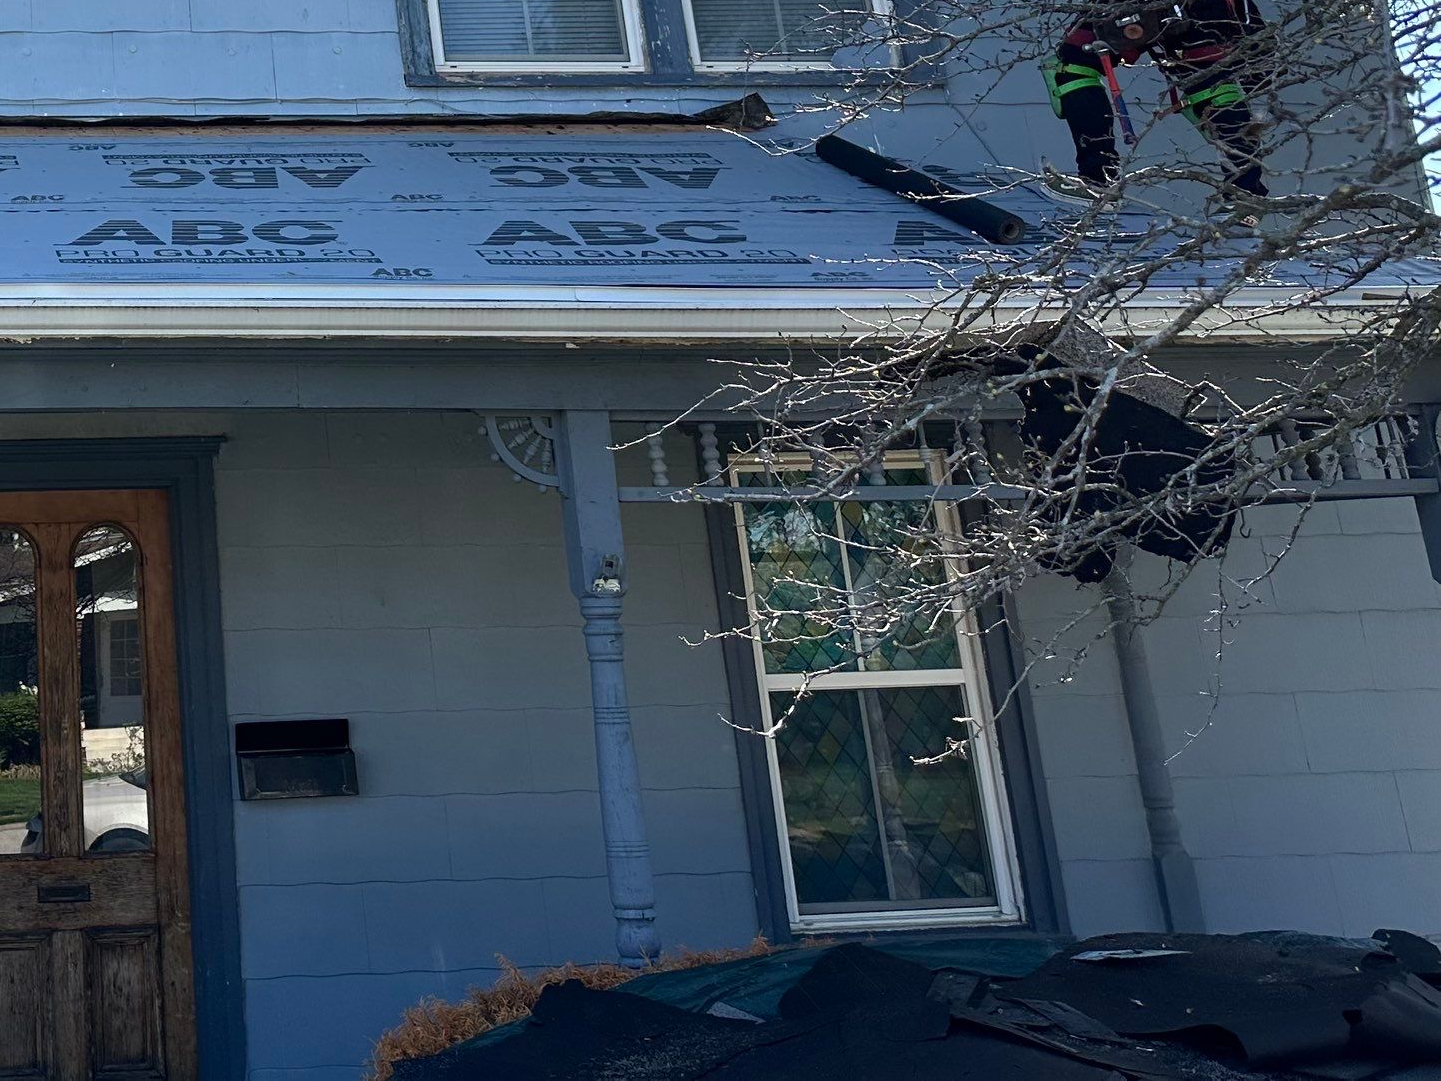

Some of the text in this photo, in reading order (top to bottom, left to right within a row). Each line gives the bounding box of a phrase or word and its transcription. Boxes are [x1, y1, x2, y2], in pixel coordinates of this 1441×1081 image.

[120, 167, 376, 189] ABC
[489, 166, 732, 188] ABC
[53, 219, 343, 246] ABC
[468, 220, 747, 246] ABC
[55, 248, 376, 257] PRO GUARD 20
[475, 249, 563, 258] PRO
[574, 249, 728, 258] GUARD
[371, 267, 433, 277] ABC
